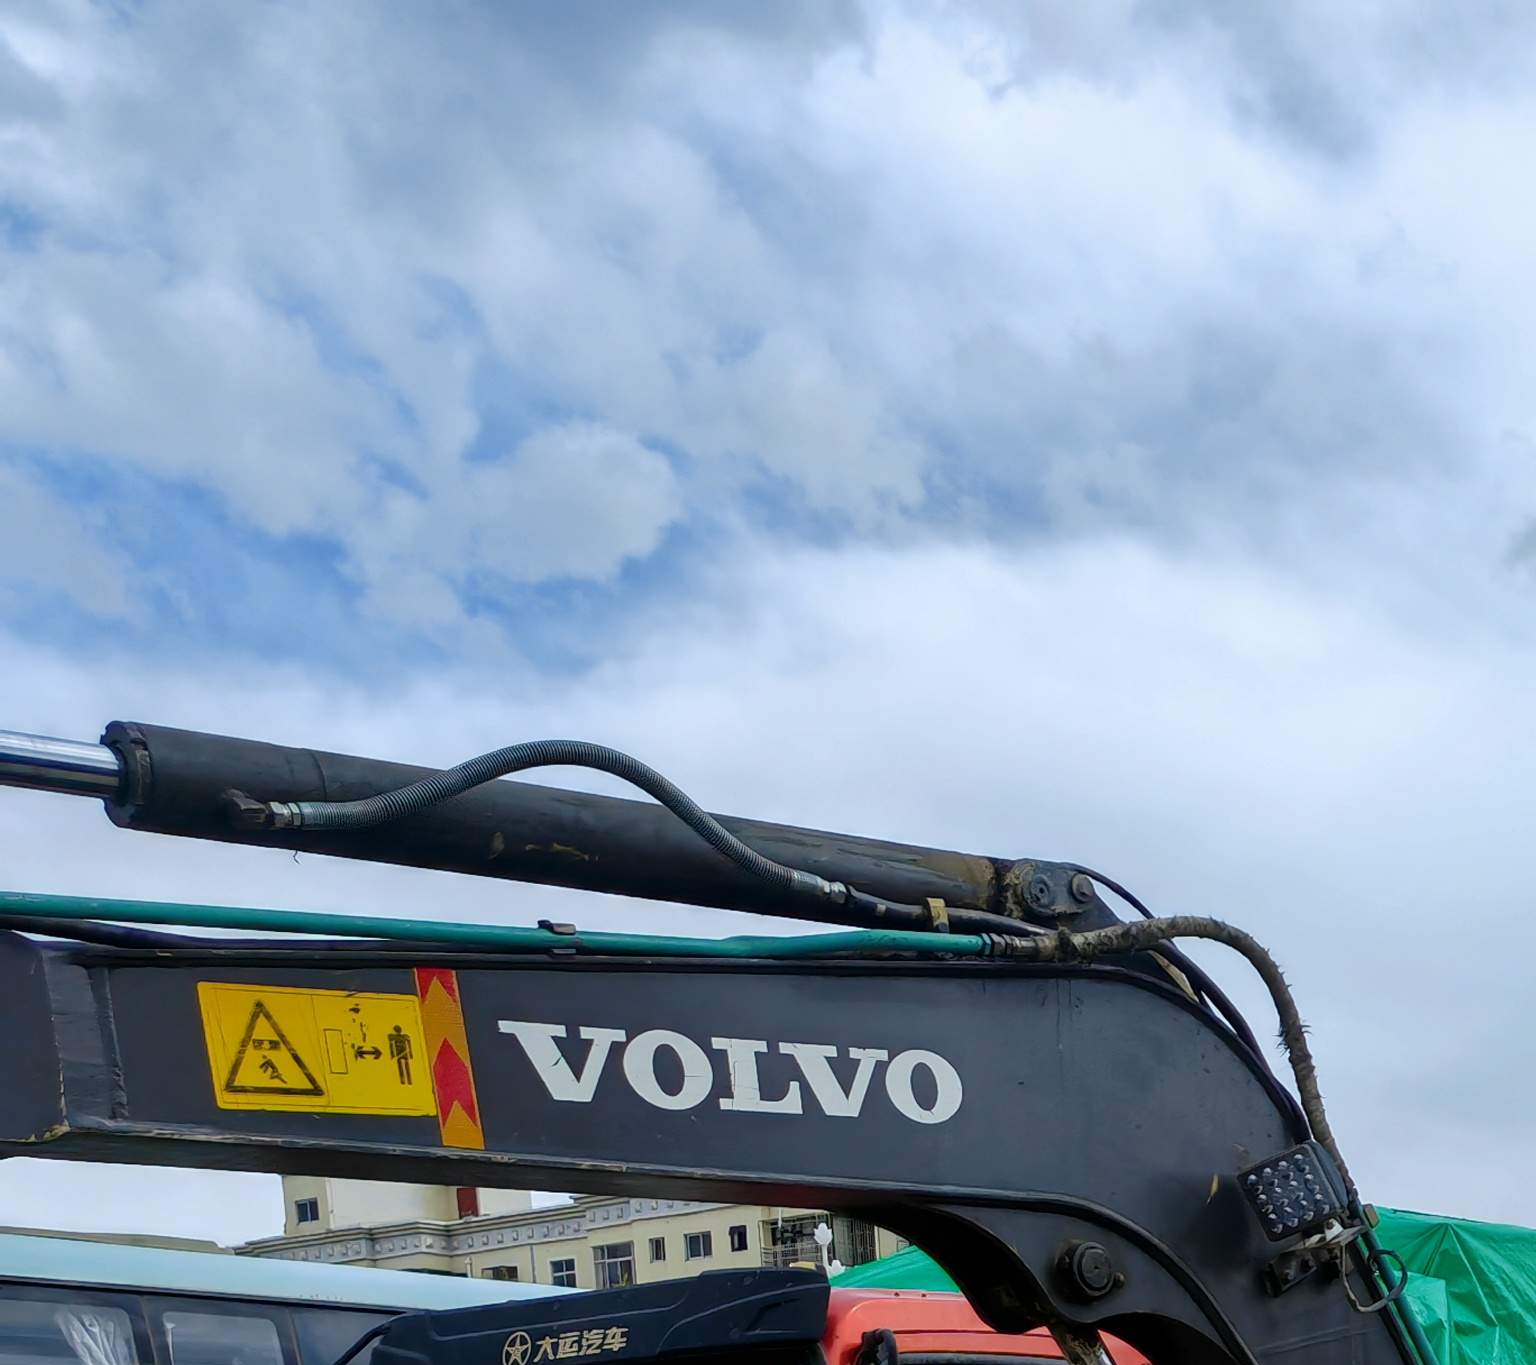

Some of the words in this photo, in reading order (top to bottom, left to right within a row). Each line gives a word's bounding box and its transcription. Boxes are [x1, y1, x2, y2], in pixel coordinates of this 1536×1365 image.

[497, 1018, 963, 1125] VOLVO
[533, 1326, 629, 1363] 大运汽车
